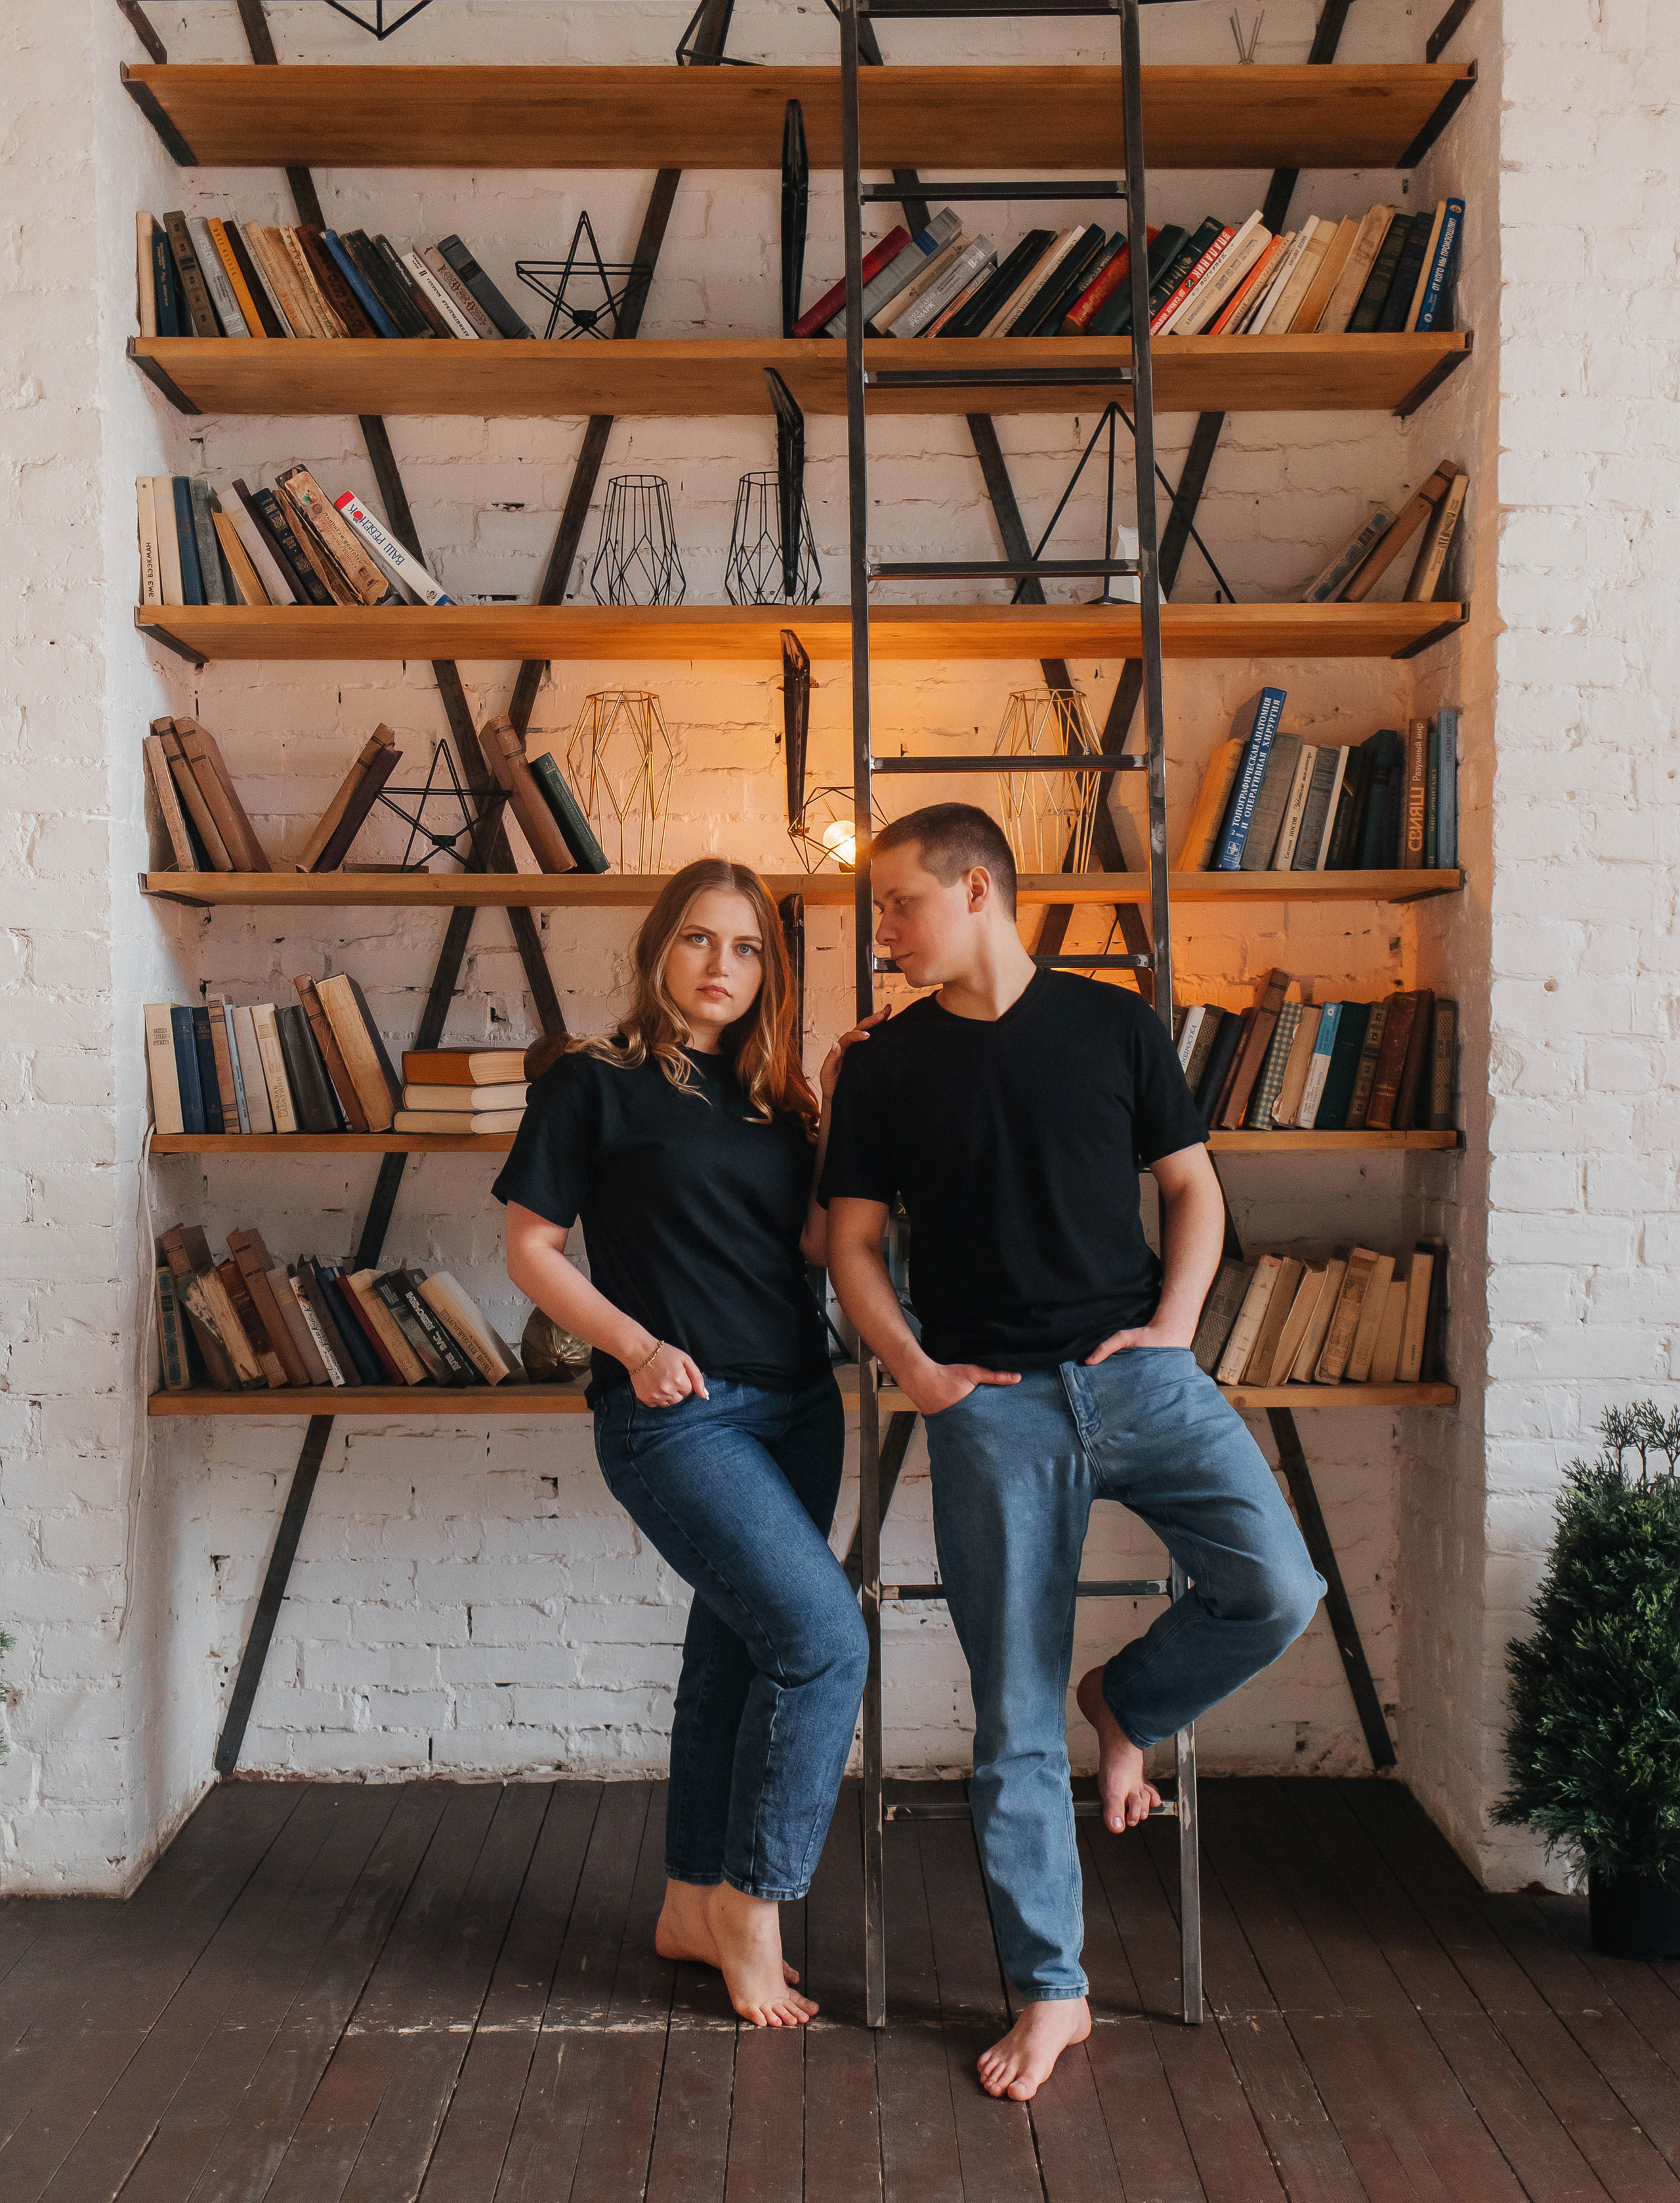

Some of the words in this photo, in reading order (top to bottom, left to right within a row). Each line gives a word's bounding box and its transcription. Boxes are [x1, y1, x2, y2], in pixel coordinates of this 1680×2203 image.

[1440, 216, 1458, 257] ПРОИЗОШЛИ?
[1190, 236, 1228, 280] ПАЛАНИК
[1437, 255, 1446, 267] МЫ
[1431, 281, 1440, 291] ОТ
[1433, 266, 1444, 282] КОГО
[1164, 295, 1181, 314] САМЫХ
[1177, 287, 1186, 298] ДО
[441, 299, 470, 337] ЛЕНИНГРАДСКАЯ
[381, 541, 406, 566] ВАШ
[1261, 698, 1281, 747] ХИРУРГИЯ
[1415, 722, 1425, 740] мир
[1232, 743, 1259, 827] ТОПОГРАФИЧЕСКАЯ
[1253, 696, 1272, 744] АНАТОМИЯ
[1412, 740, 1425, 782] Разумный
[1243, 751, 1267, 818] ОПЕРАТИВНАЯ
[1240, 821, 1249, 829] И
[1288, 816, 1298, 837] НОСОВ
[1407, 786, 1425, 852] СВИЯШ
[271, 1084, 284, 1118] РАФАЭЛЬ
[275, 1075, 289, 1118] САБАТИНИ
[404, 1290, 436, 1332] ДЕВОЧКИ
[430, 1330, 449, 1351] ВАС,
[444, 1351, 461, 1372] ДЛЯ
[474, 1354, 493, 1374] ПОЭМА
